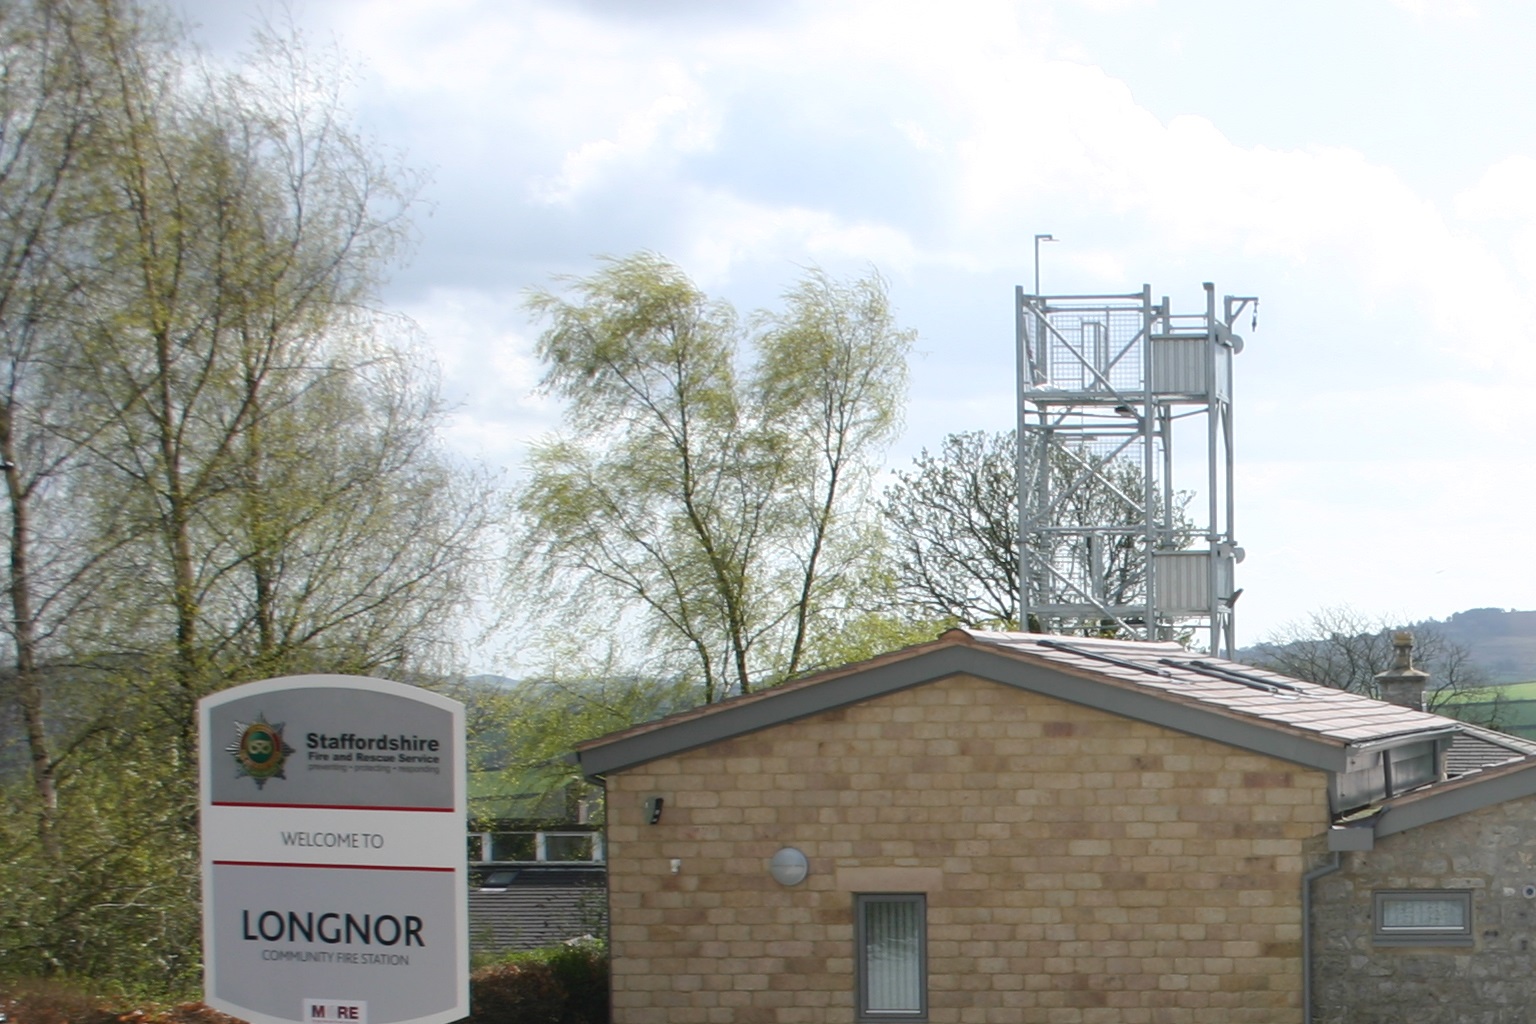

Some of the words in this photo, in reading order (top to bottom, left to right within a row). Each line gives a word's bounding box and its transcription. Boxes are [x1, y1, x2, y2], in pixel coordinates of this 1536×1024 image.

[306, 732, 439, 751] Staffordshire
[308, 752, 329, 761] Fire
[332, 753, 353, 761] and
[356, 753, 395, 762] Rescue
[398, 754, 440, 763] Service
[281, 831, 360, 848] WELCOME
[361, 833, 384, 849] TO
[243, 908, 426, 947] LONGNOR
[262, 949, 335, 963] COMMUNITY
[336, 951, 359, 964] FIRE
[360, 953, 410, 966] STATION
[312, 1004, 359, 1019] MRE
